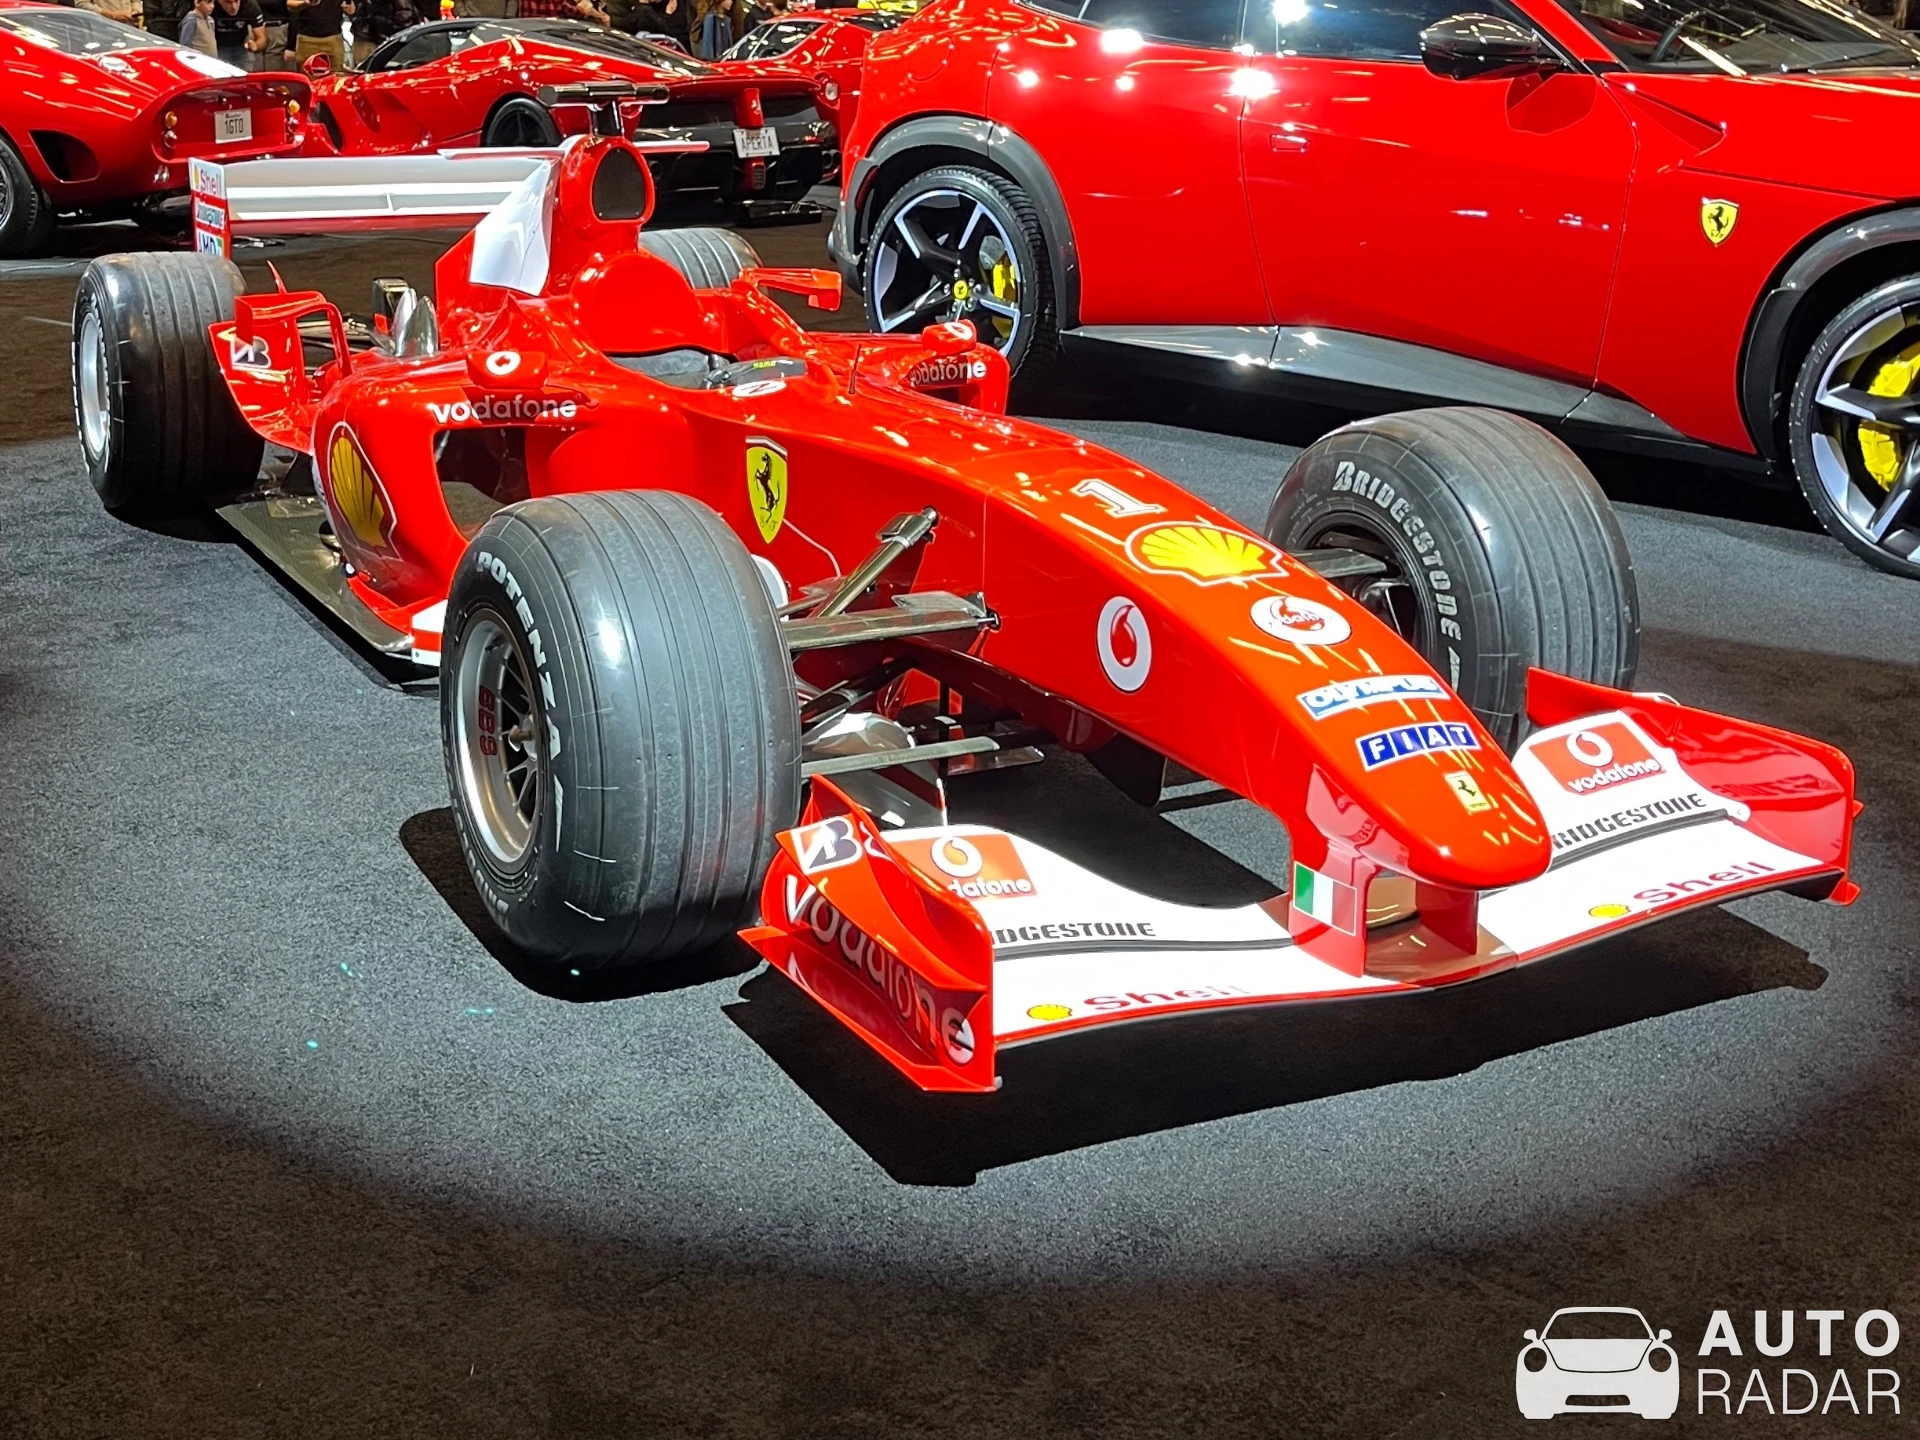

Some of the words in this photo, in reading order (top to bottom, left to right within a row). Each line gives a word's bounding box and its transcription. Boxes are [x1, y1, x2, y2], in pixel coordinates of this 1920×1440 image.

[200, 168, 222, 198] Shell
[426, 393, 577, 424] vodafone
[1332, 461, 1462, 641] BRIDGESTONE
[475, 550, 561, 761] POTENZA
[478, 684, 498, 757] BBS
[1366, 725, 1470, 761] FIAT
[1567, 757, 1661, 794] vodafone
[1551, 792, 1707, 849] RIDGESTONE
[948, 876, 1032, 898] dafone
[1633, 861, 1776, 904] Shell
[989, 922, 1156, 945] DGESTONE
[1083, 985, 1251, 1011] Shell
